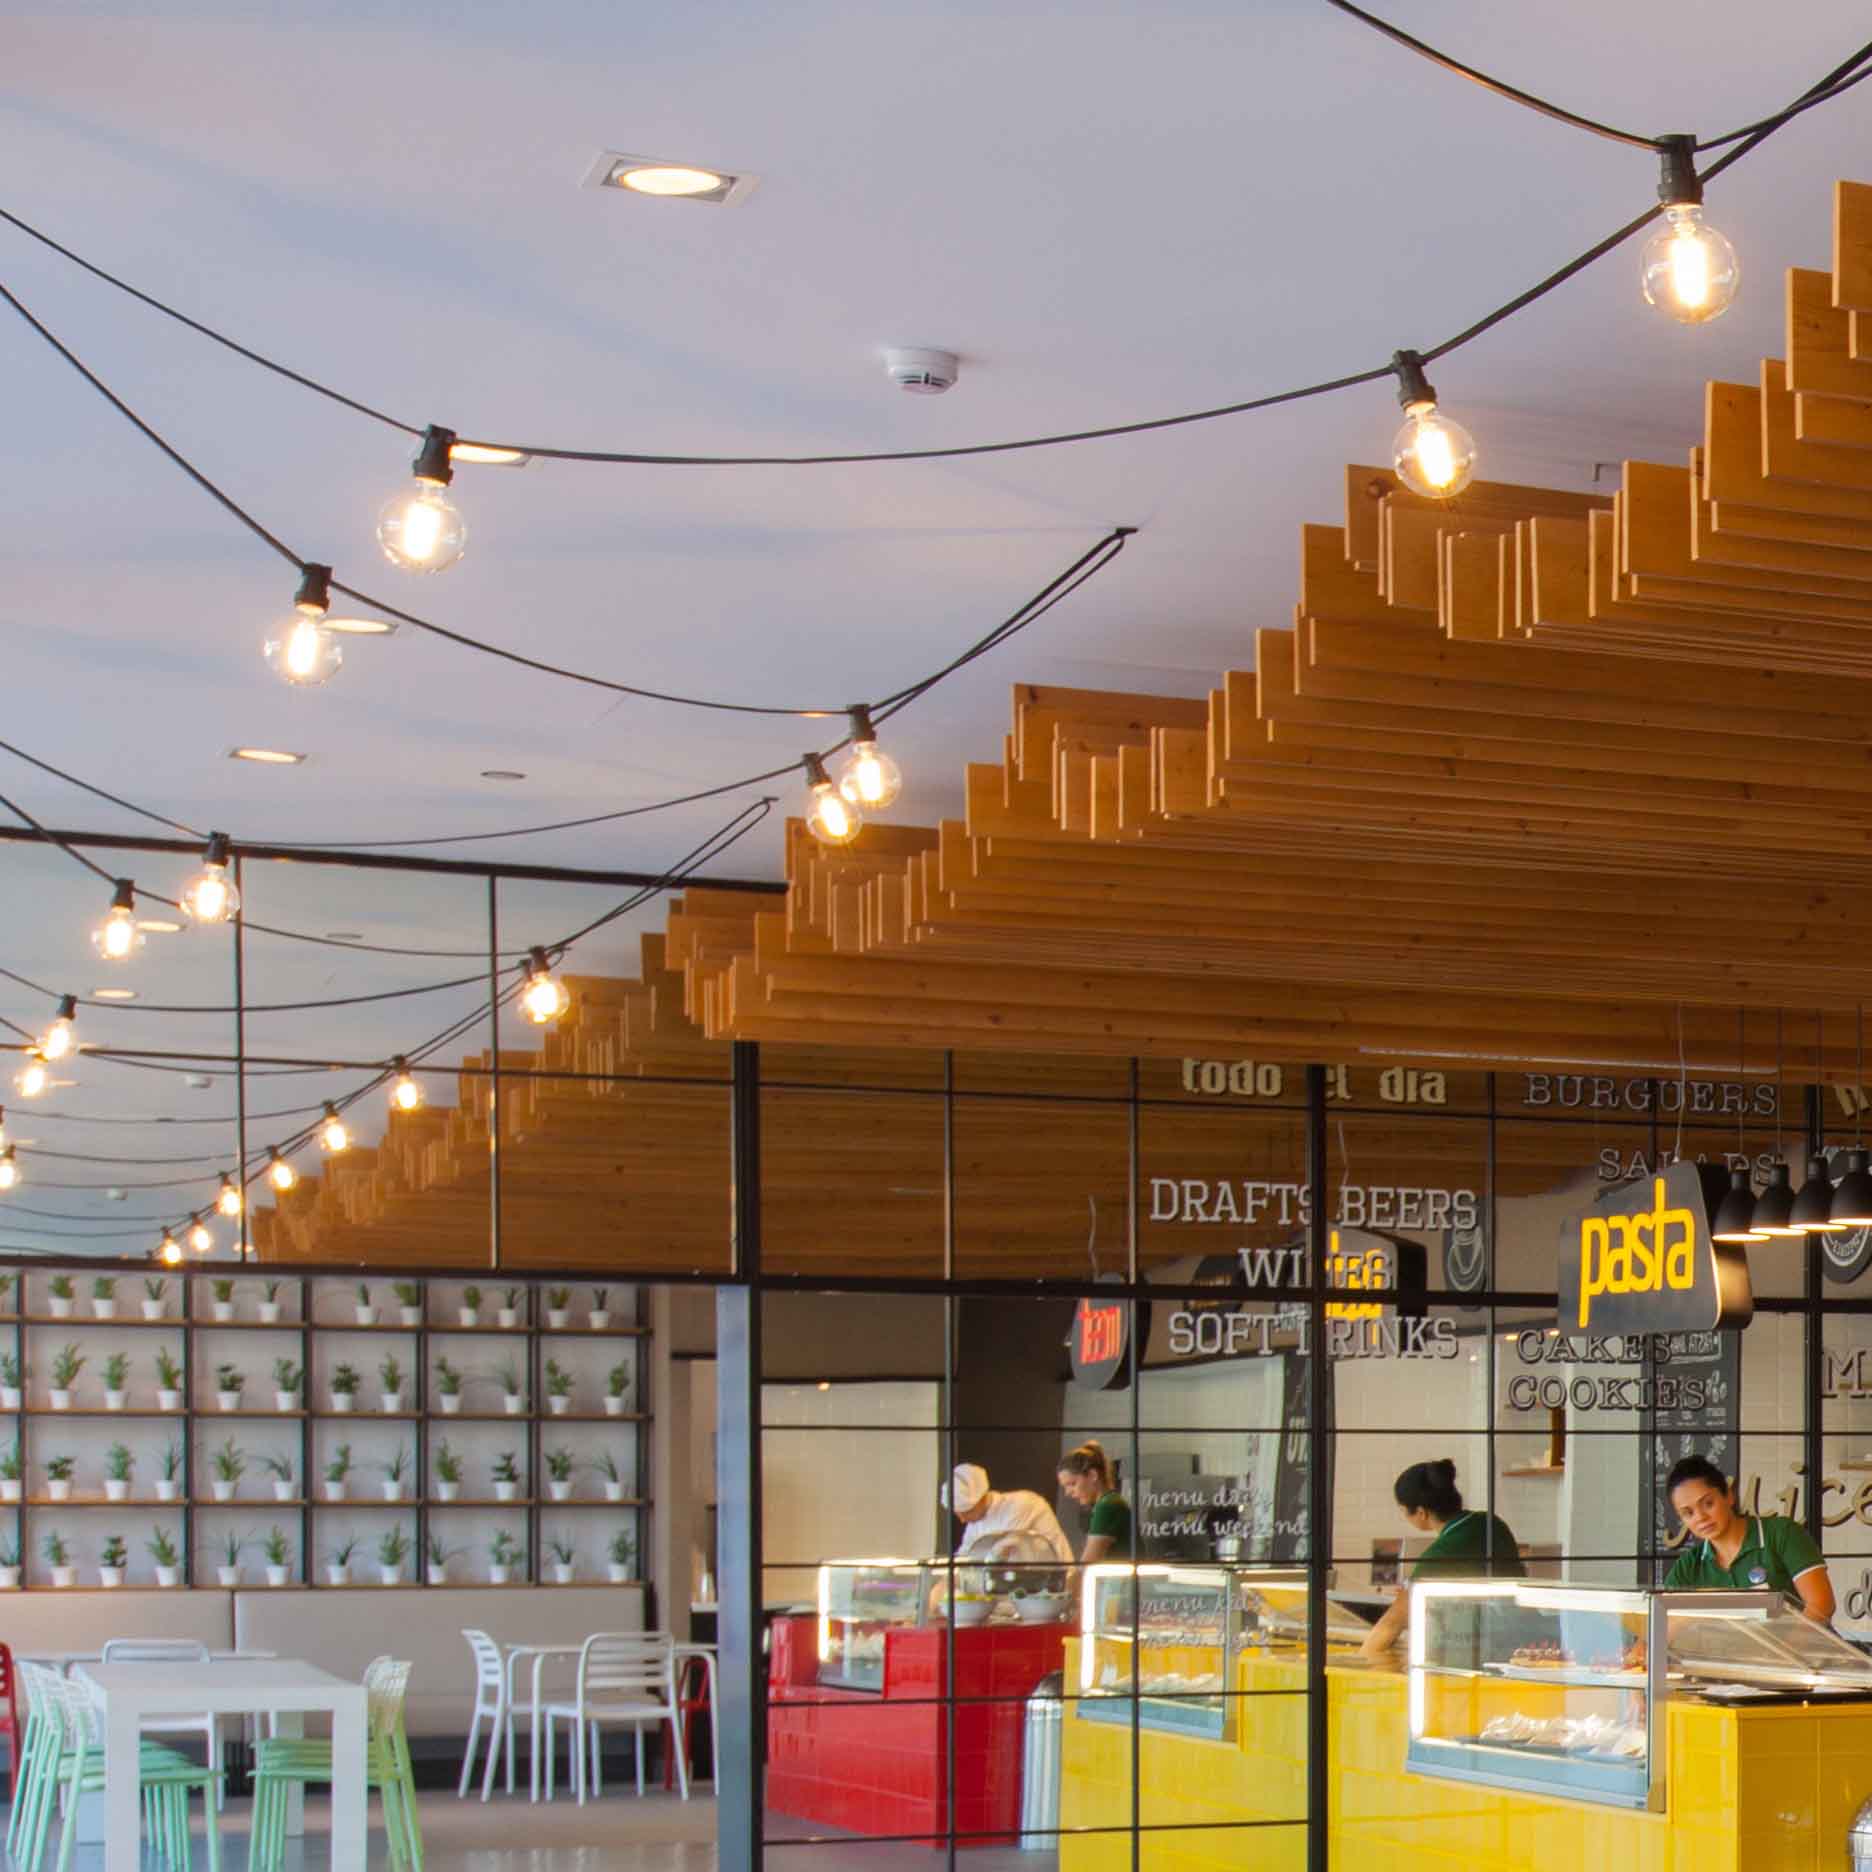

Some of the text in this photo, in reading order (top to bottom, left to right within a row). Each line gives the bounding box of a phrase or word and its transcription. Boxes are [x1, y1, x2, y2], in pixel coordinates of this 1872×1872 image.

[1181, 1058, 1282, 1097] todo
[1524, 1074, 1777, 1115] BURGUERS
[1339, 1185, 1477, 1230] BEERS
[1578, 1178, 1695, 1328] pasta
[1169, 1311, 1274, 1356] SOFT
[1515, 1329, 1675, 1364] CAKES
[1509, 1375, 1708, 1411] COOKIES
[1140, 1490, 1207, 1508] menu
